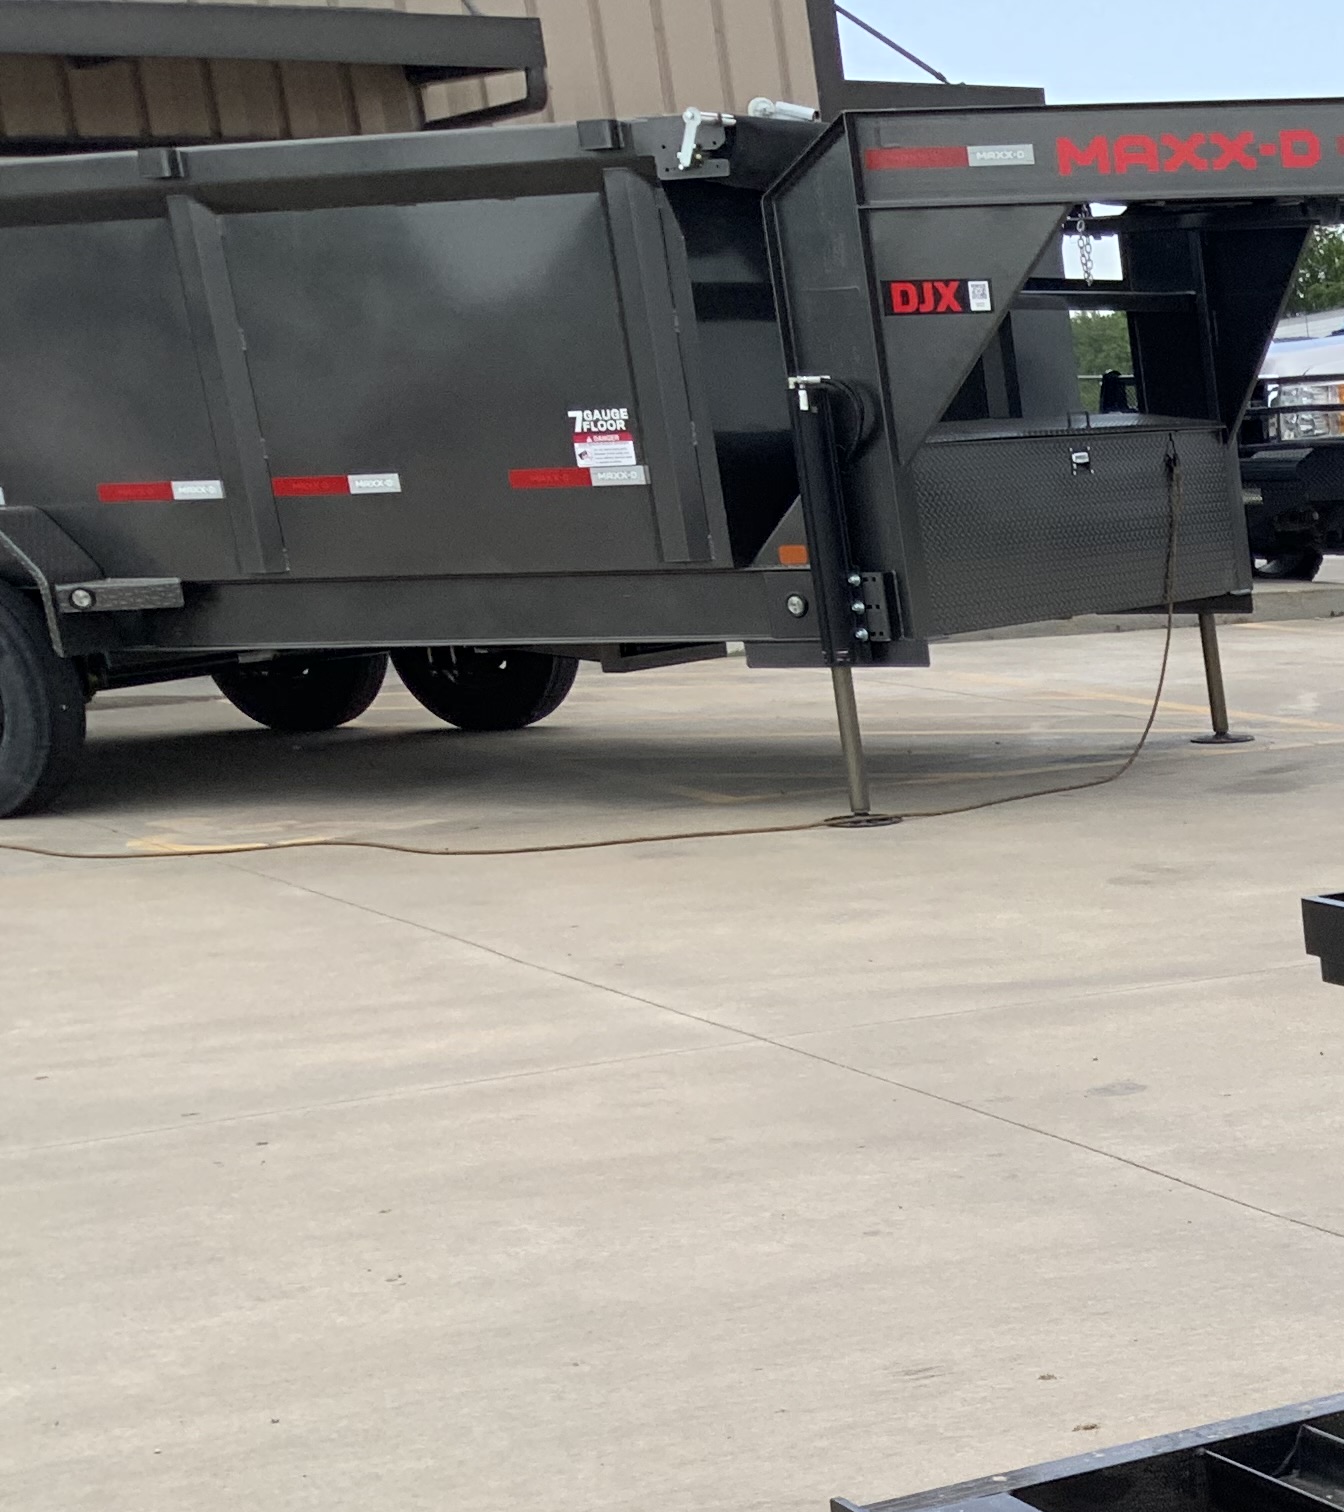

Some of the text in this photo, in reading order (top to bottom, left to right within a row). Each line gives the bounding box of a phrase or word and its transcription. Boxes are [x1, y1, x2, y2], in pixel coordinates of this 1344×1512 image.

[976, 150, 1025, 161] MAXX-D
[1056, 130, 1321, 175] MAXX-D
[891, 280, 962, 312] DJX
[567, 408, 629, 433] 7 GAUGE
[583, 419, 626, 431] FLOOR
